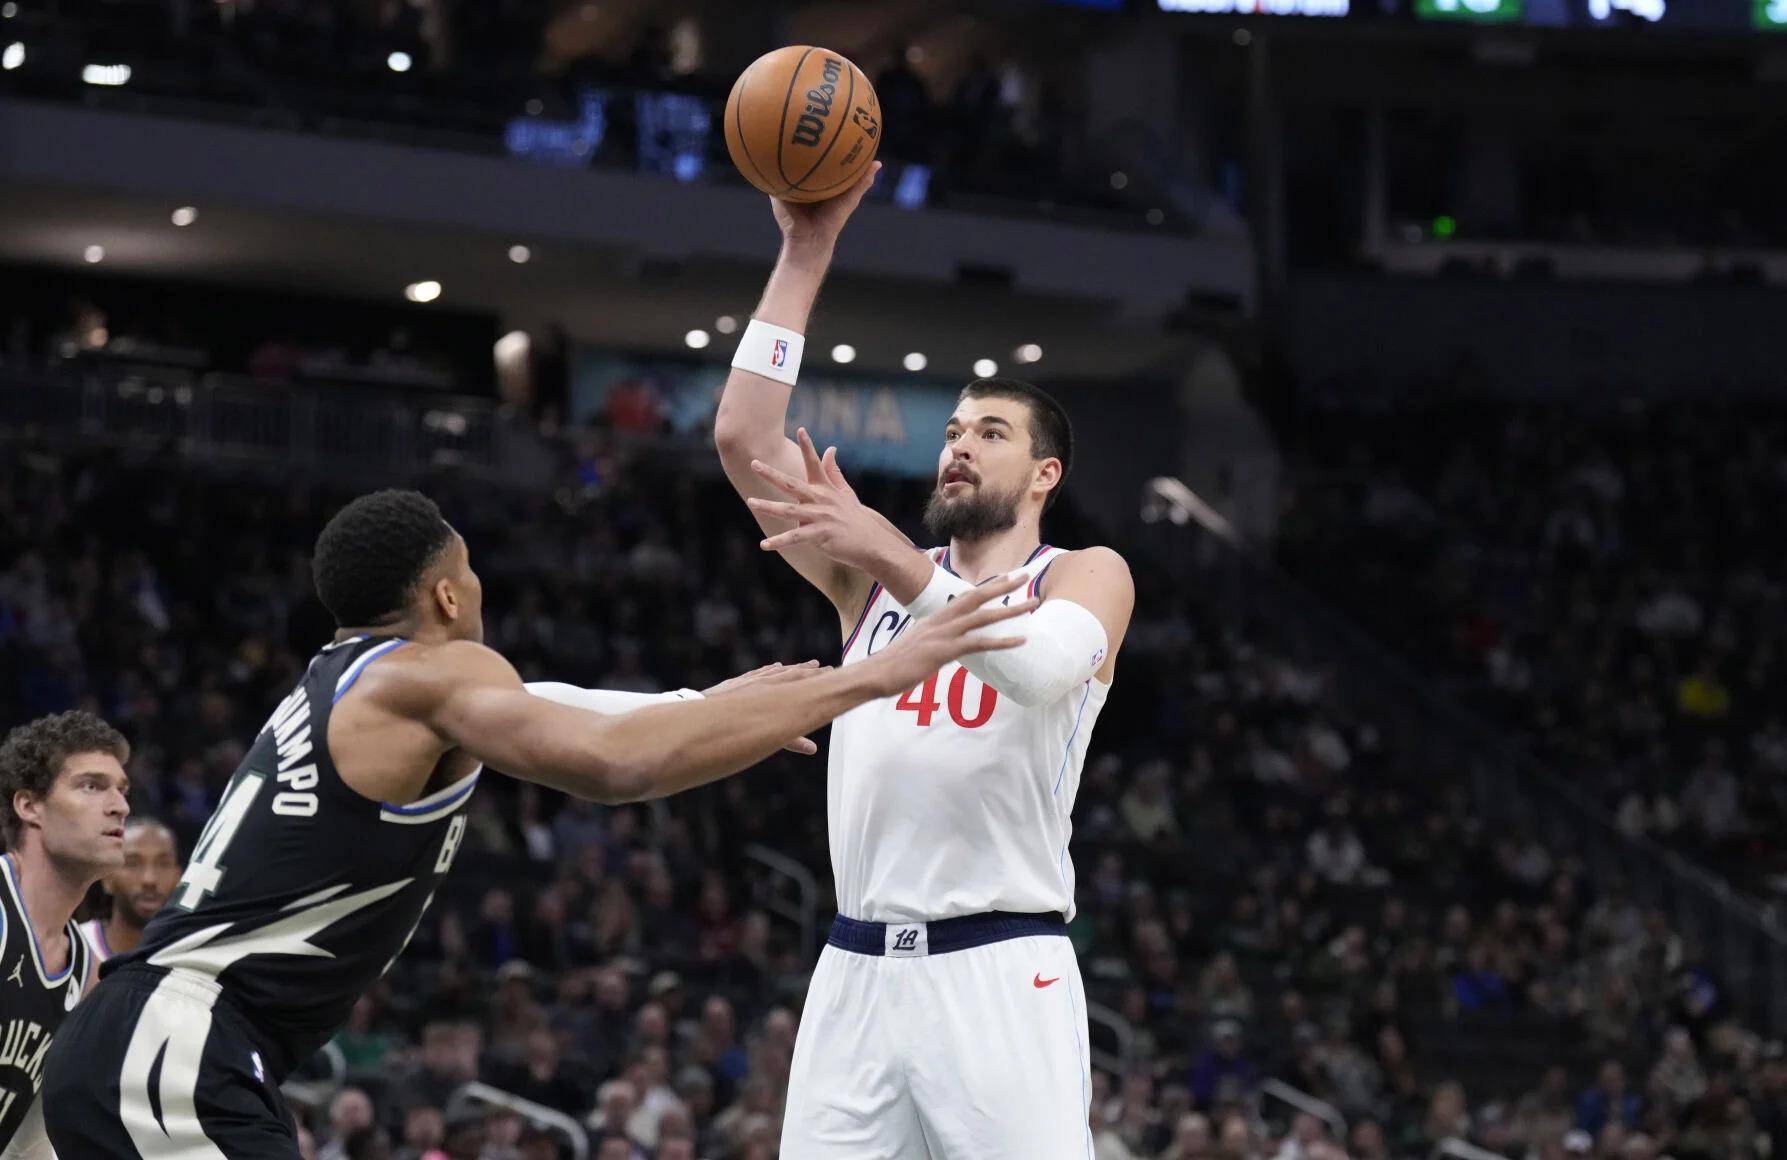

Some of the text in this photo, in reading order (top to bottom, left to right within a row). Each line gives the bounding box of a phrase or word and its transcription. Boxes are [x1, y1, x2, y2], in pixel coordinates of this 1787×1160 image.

[792, 57, 842, 147] Wilson
[896, 665, 998, 729] 40
[178, 772, 266, 911] 4
[433, 815, 468, 873] B
[0, 1018, 53, 1095] UCK
